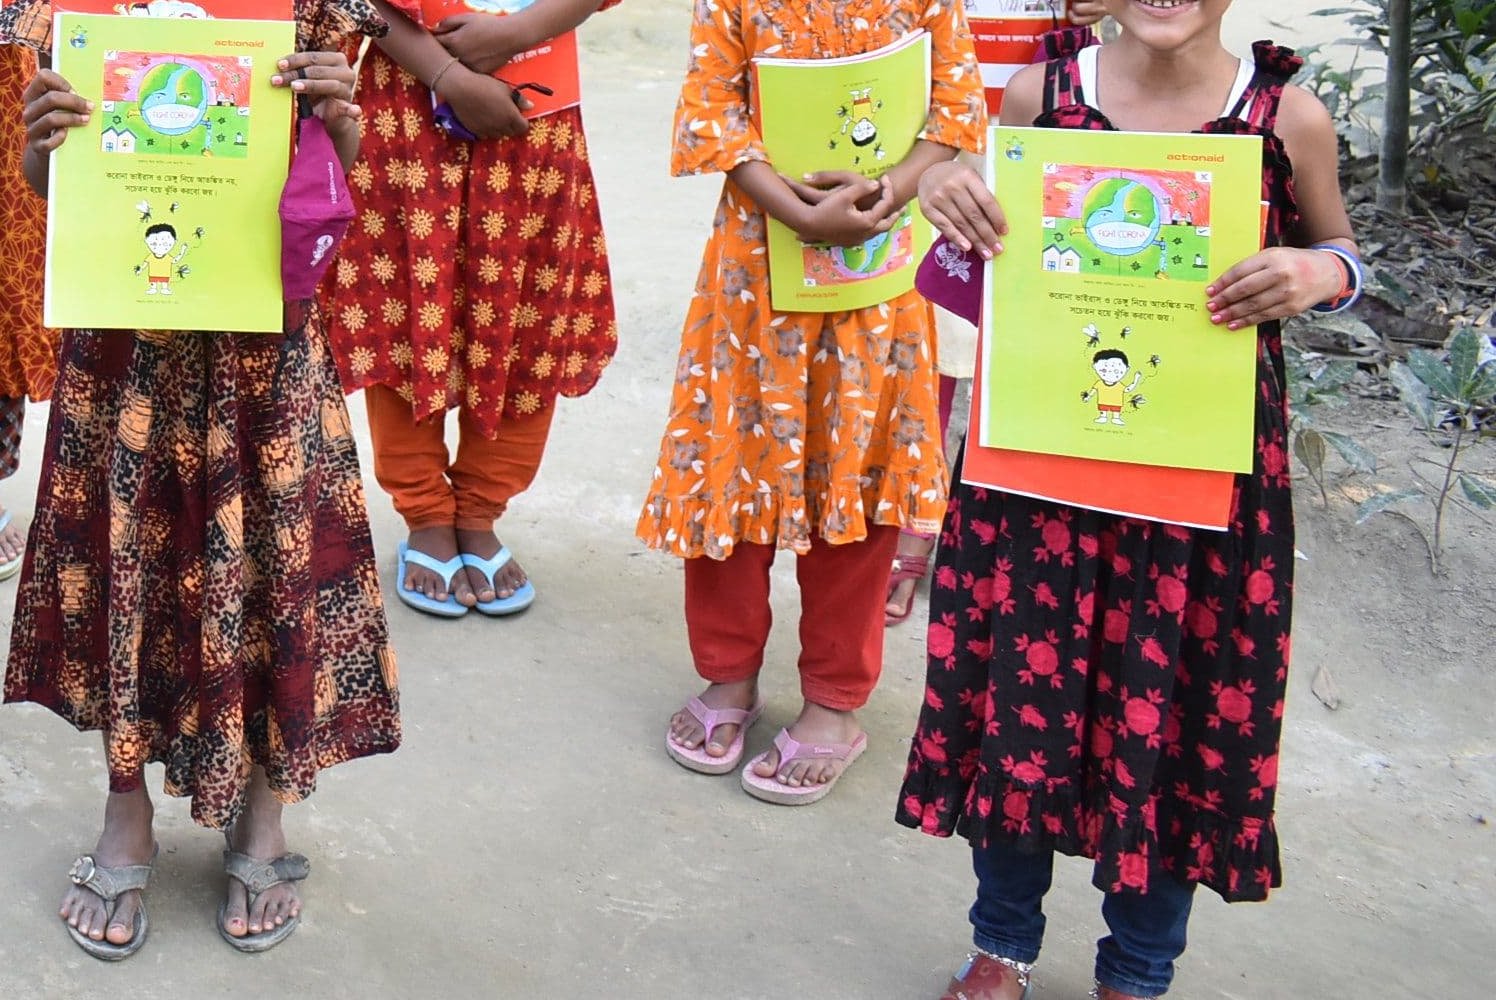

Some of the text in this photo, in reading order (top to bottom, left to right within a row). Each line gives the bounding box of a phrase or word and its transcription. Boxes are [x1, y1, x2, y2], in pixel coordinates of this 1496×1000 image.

[106, 172, 128, 180] করোনা
[1048, 291, 1073, 300] করোনা
[1075, 293, 1101, 304] ভাইরাস
[1131, 297, 1147, 307] নিয়ে
[1069, 306, 1095, 316] সচেতন
[1098, 308, 1111, 317] হয়ে
[1132, 312, 1154, 321] করবো
